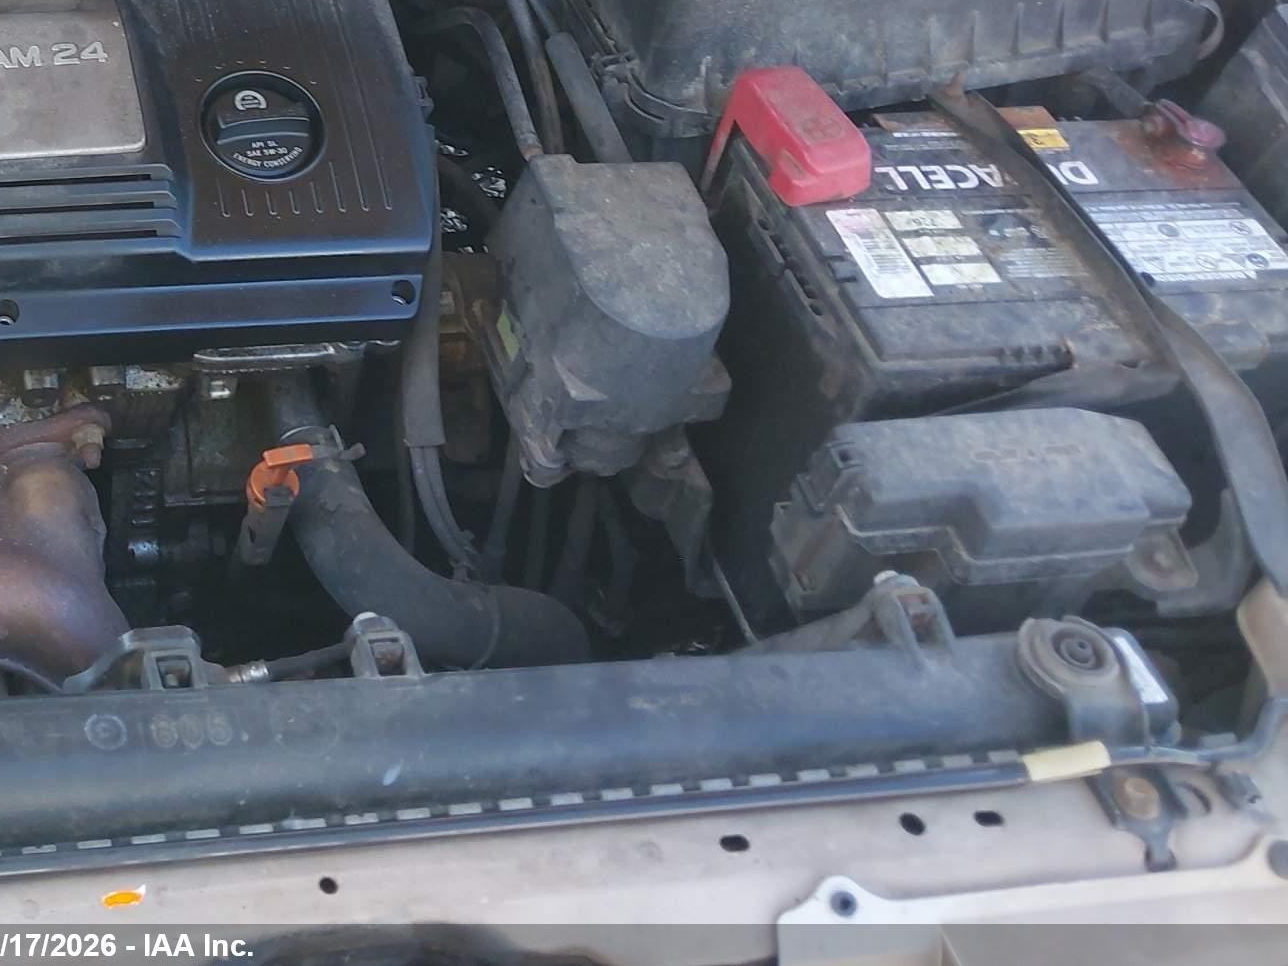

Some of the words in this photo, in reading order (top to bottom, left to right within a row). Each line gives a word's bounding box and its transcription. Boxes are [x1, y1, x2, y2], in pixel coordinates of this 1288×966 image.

[51, 40, 108, 67] 24
[233, 153, 262, 167] ENERGY
[263, 147, 303, 168] CONSERVING
